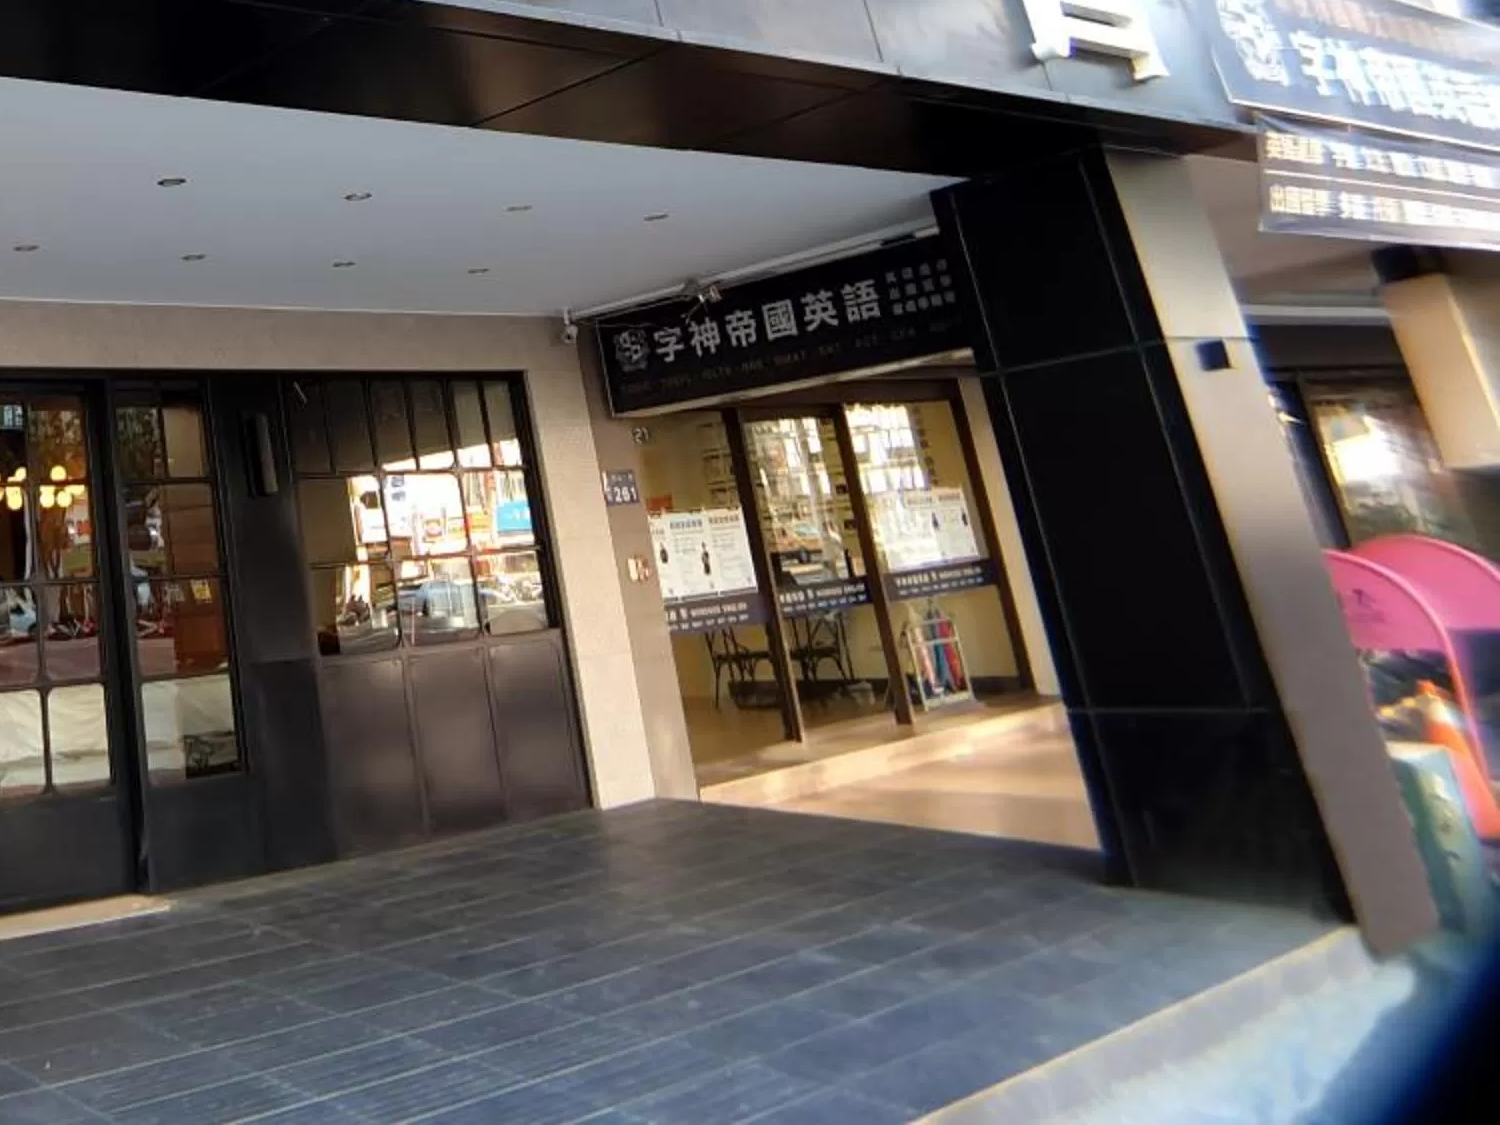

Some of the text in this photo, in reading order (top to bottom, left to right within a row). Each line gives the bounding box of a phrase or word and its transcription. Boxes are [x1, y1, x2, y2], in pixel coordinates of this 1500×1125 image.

[653, 279, 880, 363] 字神帝國英語
